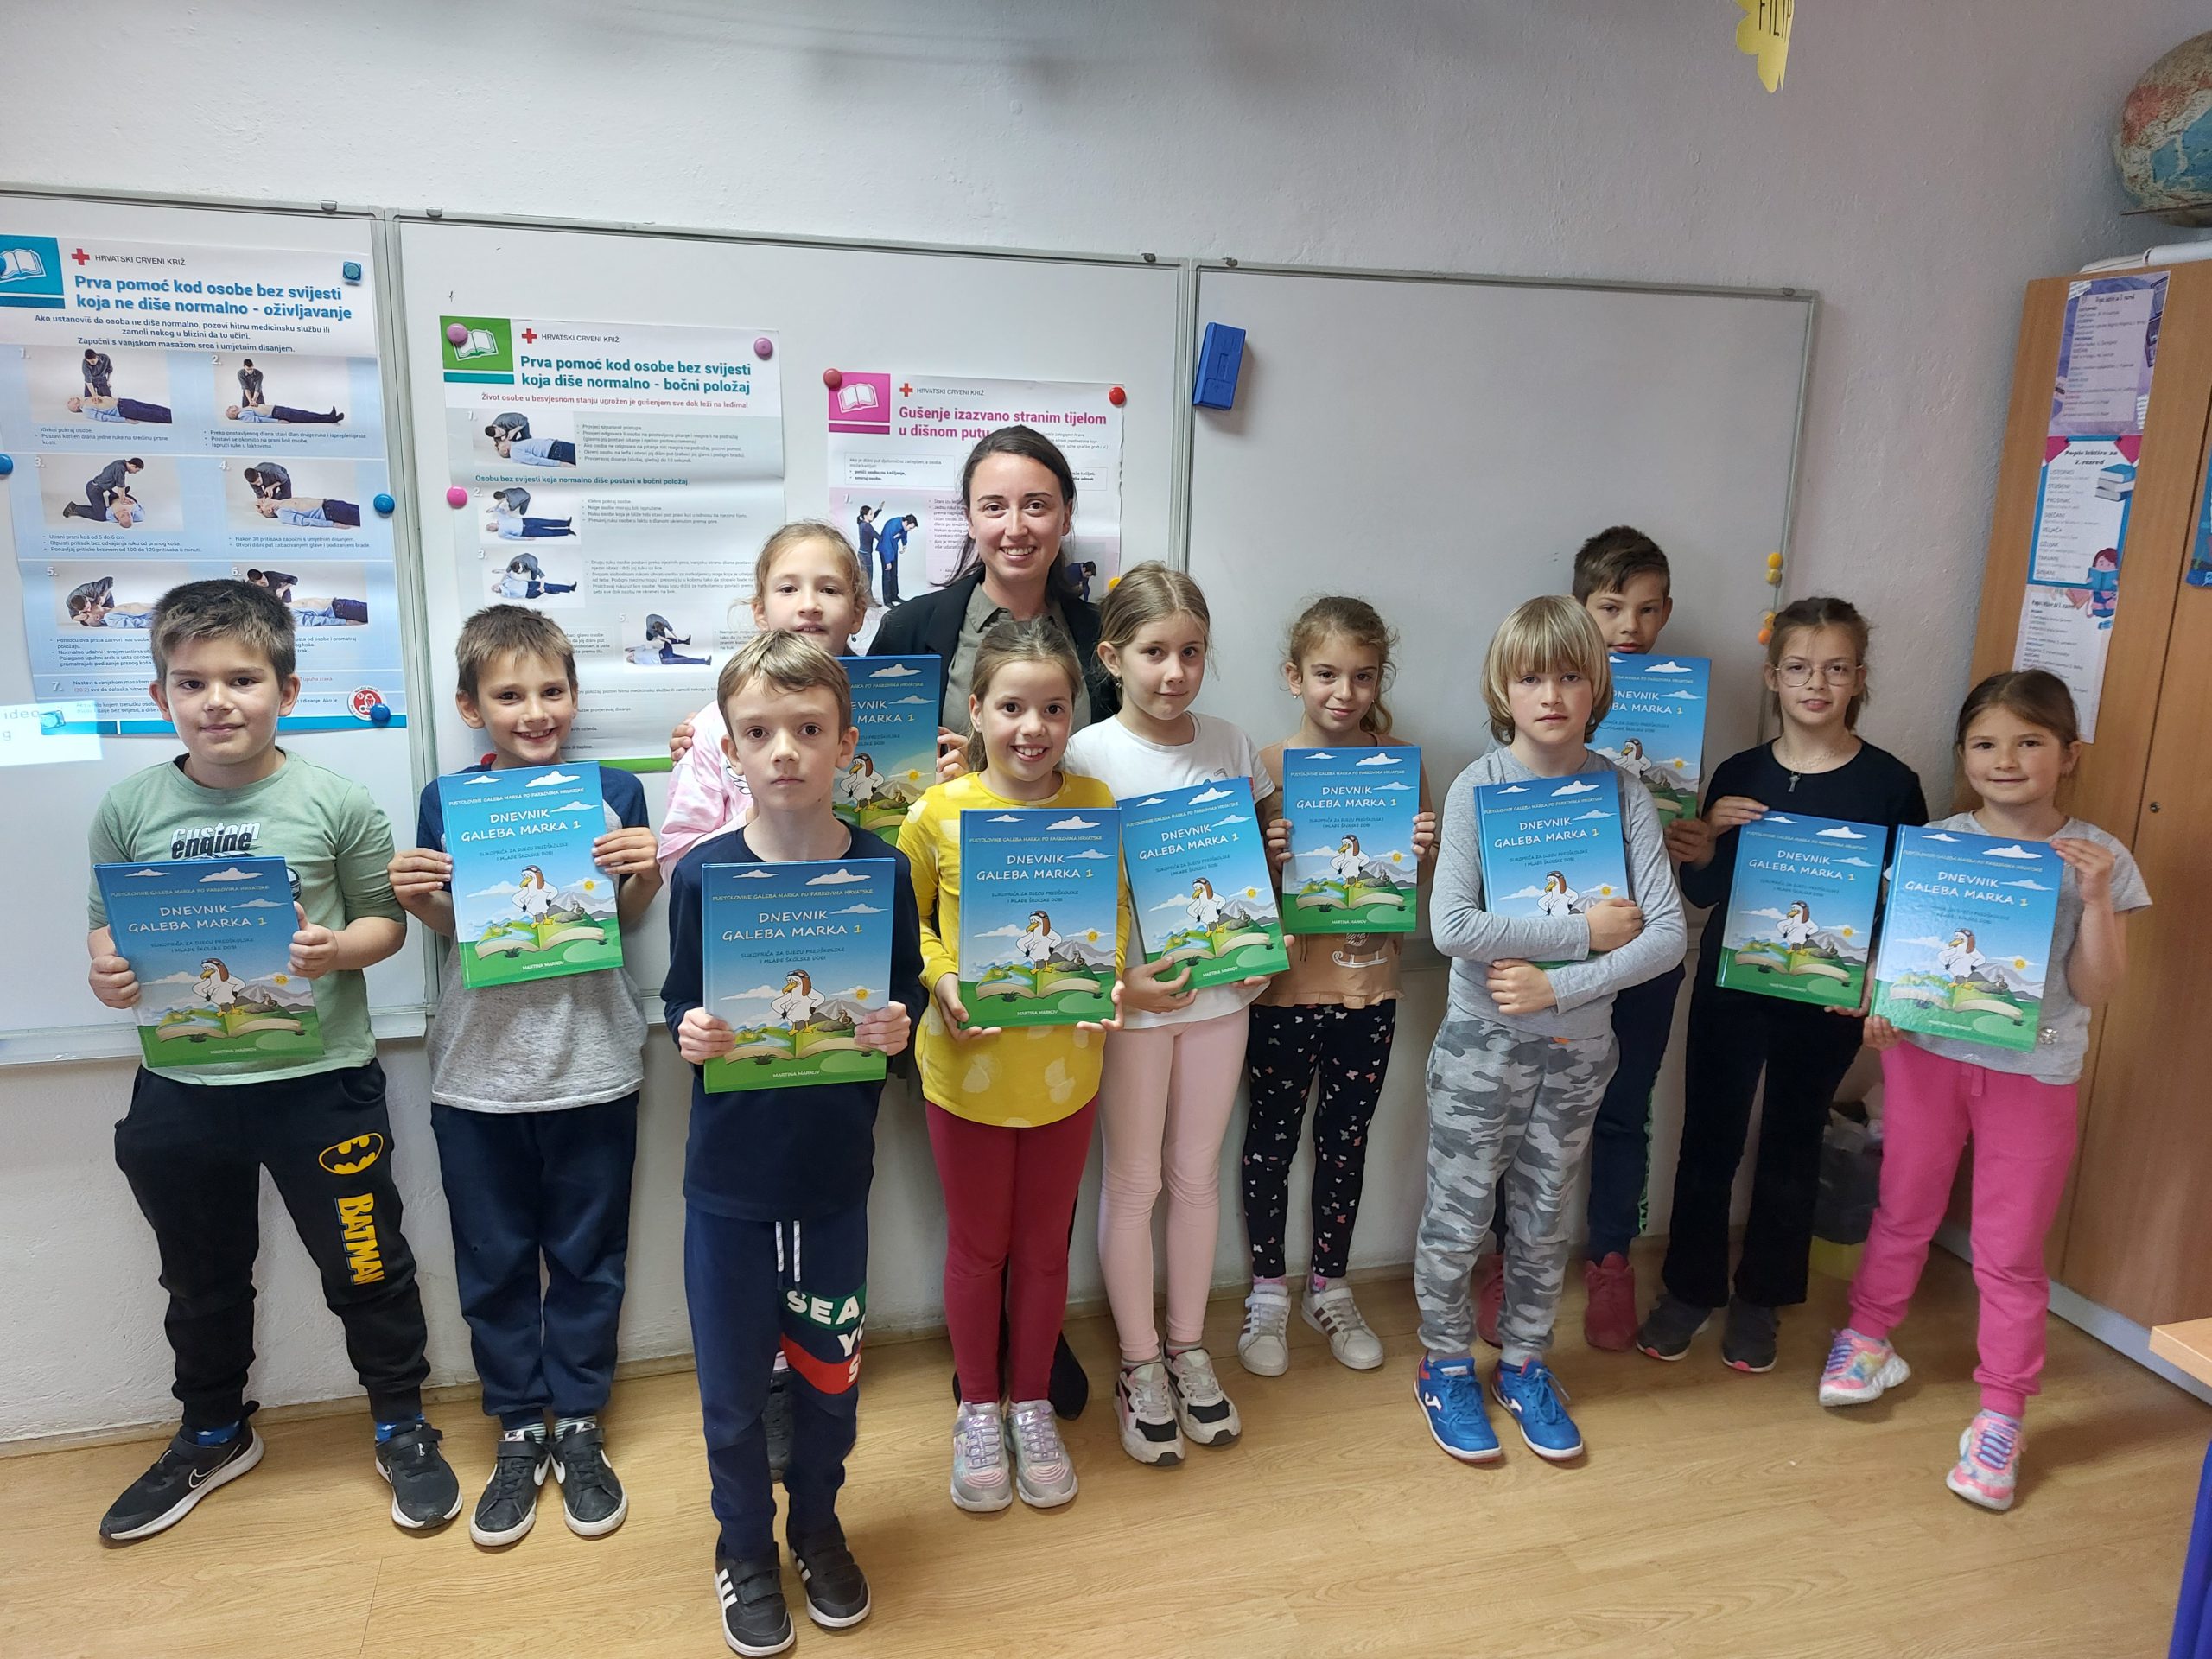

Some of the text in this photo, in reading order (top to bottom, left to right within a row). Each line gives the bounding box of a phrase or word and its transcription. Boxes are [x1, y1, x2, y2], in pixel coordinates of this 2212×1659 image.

[167, 257, 186, 266] KRIŽ
[74, 275, 342, 302] Prva pomoć kod osobe bez svijesti
[76, 294, 111, 312] koja
[115, 299, 134, 309] ne
[138, 296, 171, 312] diše
[175, 300, 248, 315] normalno
[264, 302, 352, 322] oživljavanje
[143, 318, 160, 327] diše
[162, 321, 201, 329] normalno,
[202, 321, 228, 330] pozovi
[251, 323, 296, 332] medicinsku
[296, 325, 322, 334] službu
[150, 328, 175, 339] nekog
[182, 329, 207, 338] blizini
[78, 337, 110, 346] Započni
[118, 339, 156, 348] vanjskom
[158, 340, 196, 349] masažom
[258, 344, 296, 353] disanjem.
[520, 355, 751, 378] Prva pomoć kod osobe bez svijesti
[521, 372, 551, 389] koja
[555, 374, 583, 387] diše
[587, 376, 651, 390] normalno
[664, 378, 700, 391] bočni
[703, 379, 750, 396] položaj
[481, 391, 500, 401] Život
[531, 394, 575, 404] besvjesnom
[575, 397, 598, 405] stanju
[599, 397, 628, 406] ugrožen
[637, 398, 671, 408] gušenjem
[899, 406, 1107, 427] Gušenje izazvano stranim tijelom
[899, 423, 990, 442] u dišnom putu
[542, 475, 557, 485] koja
[663, 477, 688, 486] položaj
[47, 566, 58, 576] 5.
[232, 567, 242, 576] 6.
[850, 700, 887, 710] EVNIK
[1631, 703, 1672, 714] MARKA
[857, 714, 915, 724] MARKA 1
[1322, 785, 1373, 796] DNEVNIK
[1296, 799, 1341, 810] GALEBA
[1345, 798, 1386, 808] MARKA
[489, 809, 550, 824] DNEVNIK
[1519, 817, 1573, 831] DNEVNIK
[461, 820, 582, 842] GALEBA MARKA 1
[1161, 823, 1213, 842] DNEVNIK
[1494, 828, 1599, 849] GALEBA MARKA 1
[171, 831, 253, 860] engine
[1139, 833, 1239, 860] GALEBA MARKA 1
[1007, 854, 1065, 865] DNEVNIK
[1777, 850, 1831, 865] DNEVNIK
[976, 868, 1093, 881] GALEBA MARKA 1
[1749, 859, 1796, 873] GALEBA
[1800, 866, 1843, 880] MARKA
[1937, 871, 1999, 888] DNEVNIK
[1904, 880, 2028, 906] GALEBA MARKA 1
[159, 904, 231, 917] DNEVNIK
[759, 910, 829, 924] DNEVNIK
[128, 917, 267, 933] GALEBA MARKA 1
[722, 925, 862, 942] GALEBA MARKA 1
[335, 1192, 385, 1285] BATMAN
